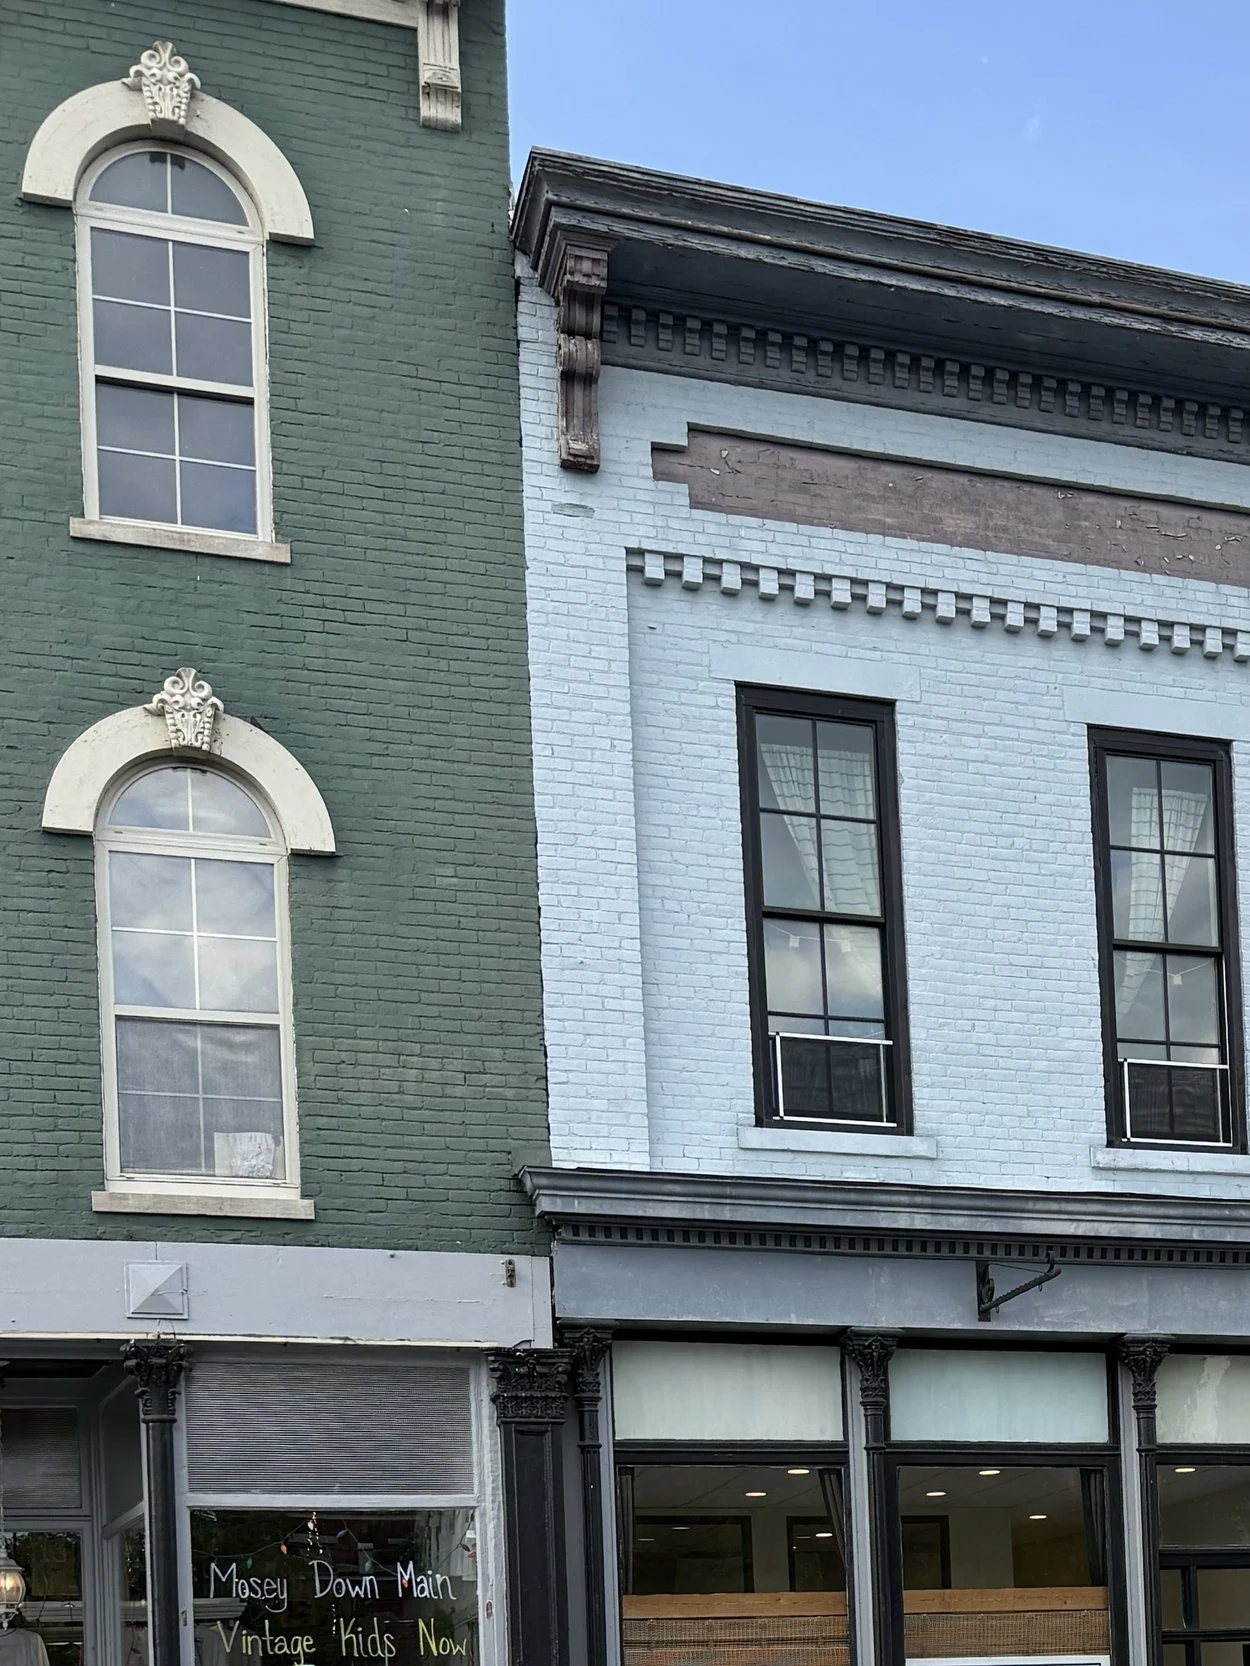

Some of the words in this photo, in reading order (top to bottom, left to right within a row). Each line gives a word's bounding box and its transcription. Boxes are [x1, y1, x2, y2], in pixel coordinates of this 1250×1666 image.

[210, 1562, 287, 1613] Mosey
[309, 1560, 379, 1599] Down
[397, 1560, 456, 1599] Main
[217, 1619, 317, 1666] Vintage
[340, 1617, 396, 1657] Kids
[418, 1618, 468, 1656] Now
